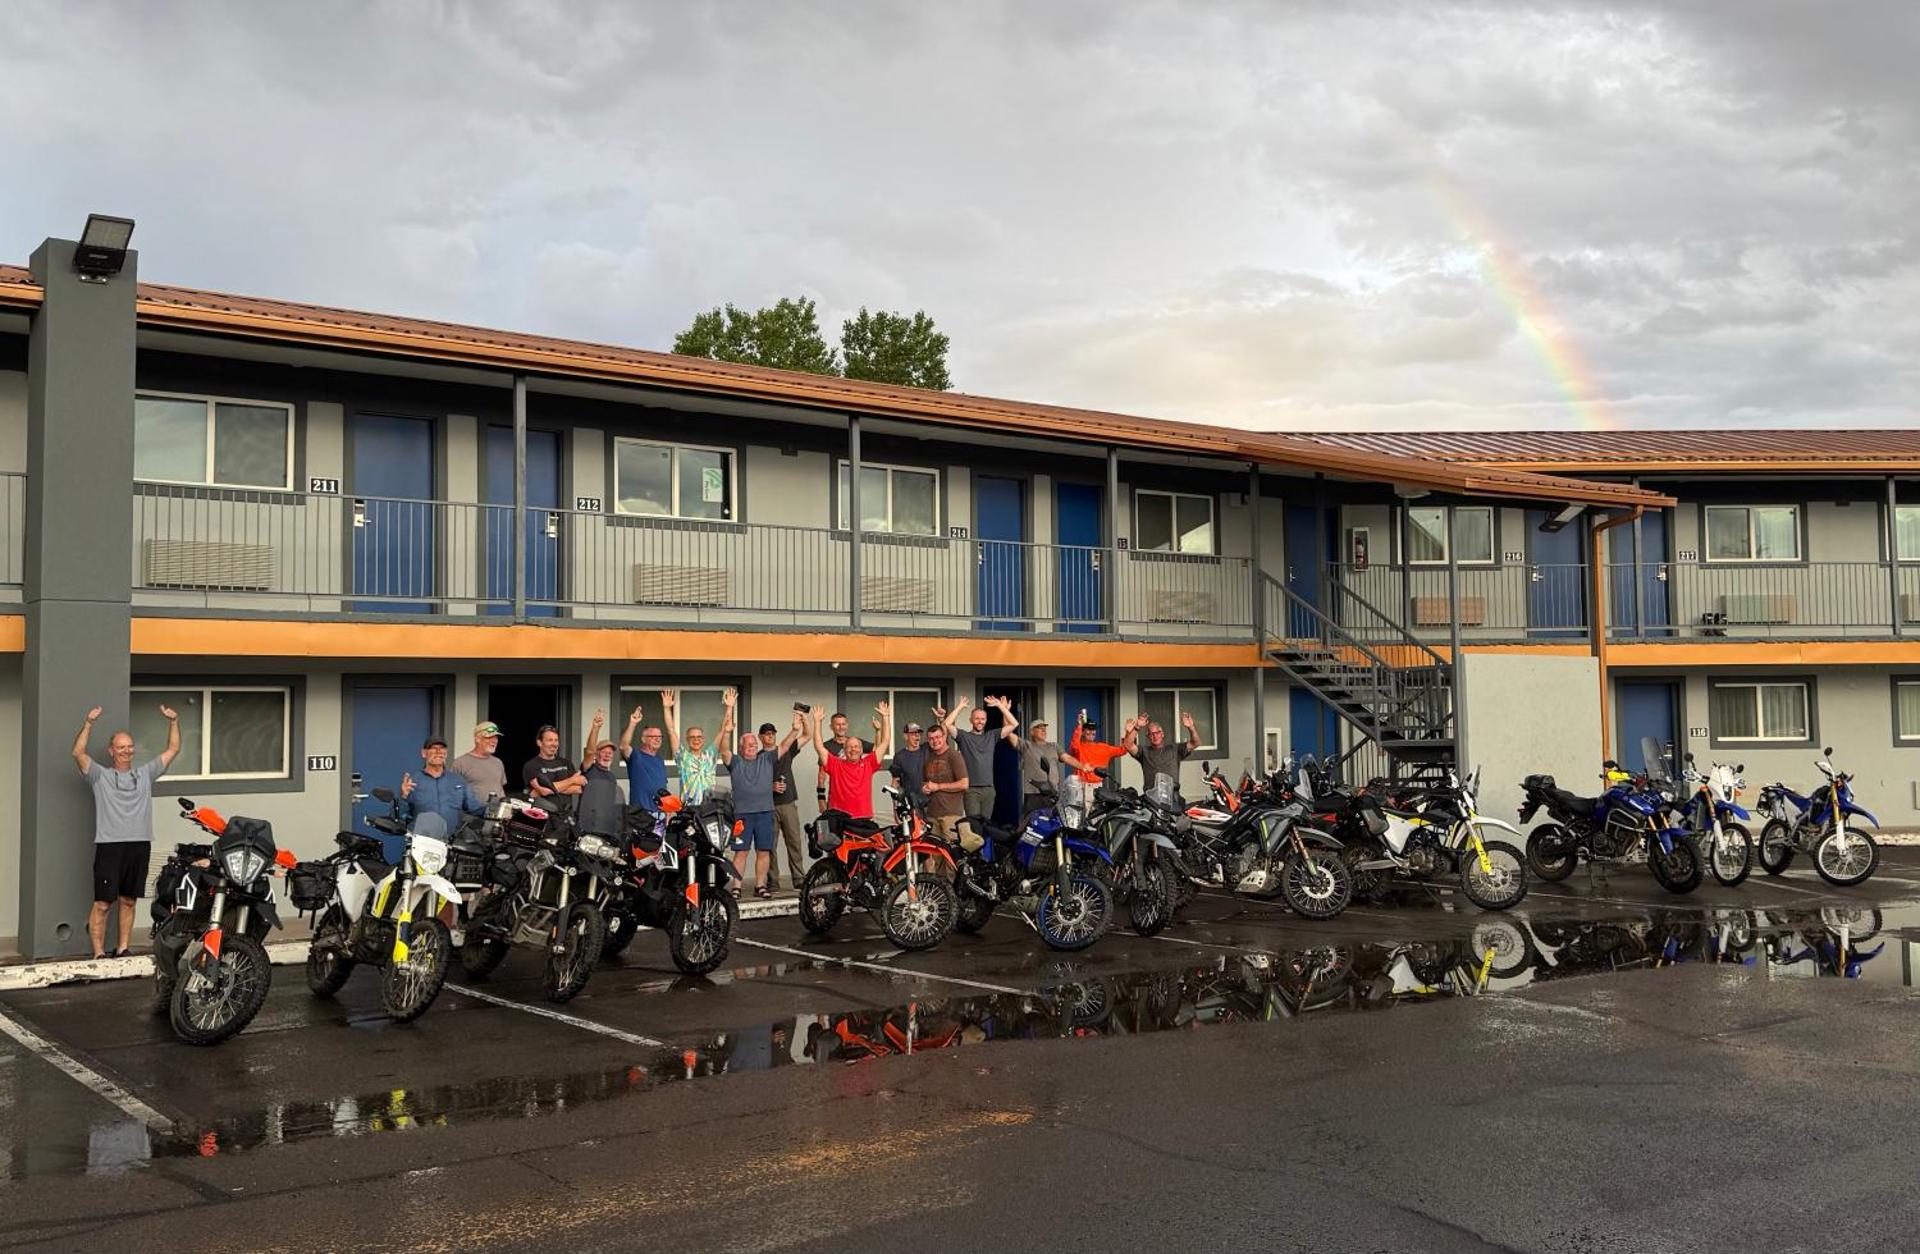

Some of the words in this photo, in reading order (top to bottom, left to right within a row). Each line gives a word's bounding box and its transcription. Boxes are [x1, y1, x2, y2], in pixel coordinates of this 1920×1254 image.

[313, 479, 336, 492] 211
[579, 498, 599, 510] 212
[952, 527, 966, 538] 214
[1118, 539, 1127, 549] 15
[310, 757, 333, 770] 110
